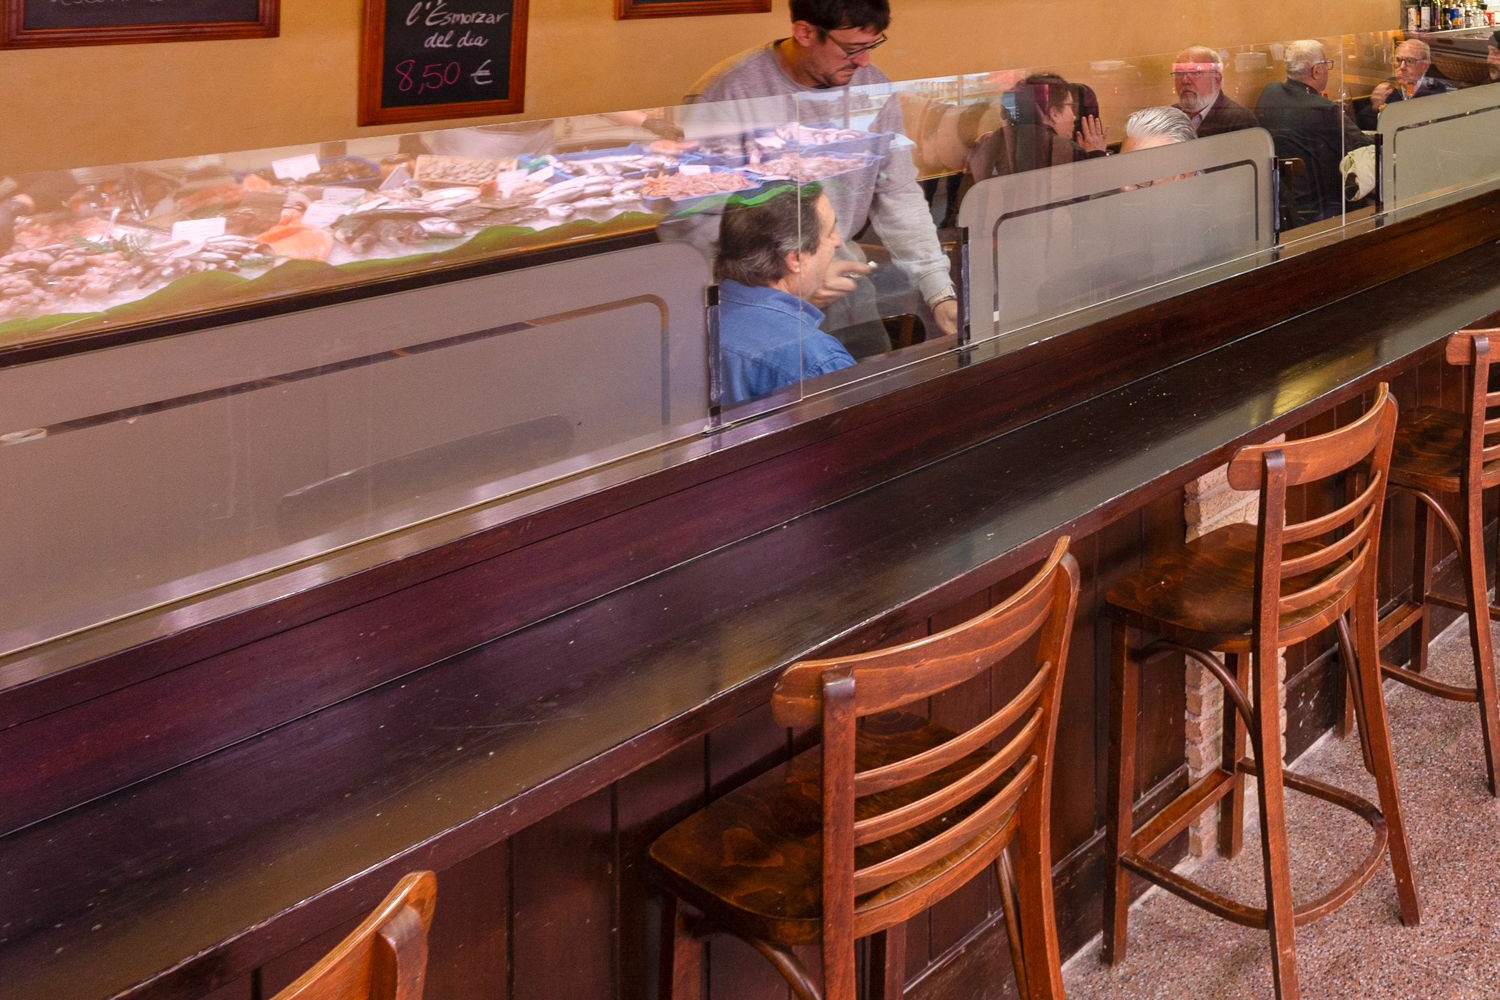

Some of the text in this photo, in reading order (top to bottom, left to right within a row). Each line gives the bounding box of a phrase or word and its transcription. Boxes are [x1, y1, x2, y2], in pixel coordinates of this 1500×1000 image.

[424, 30, 454, 48] del
[395, 59, 494, 96] 8,50 €
